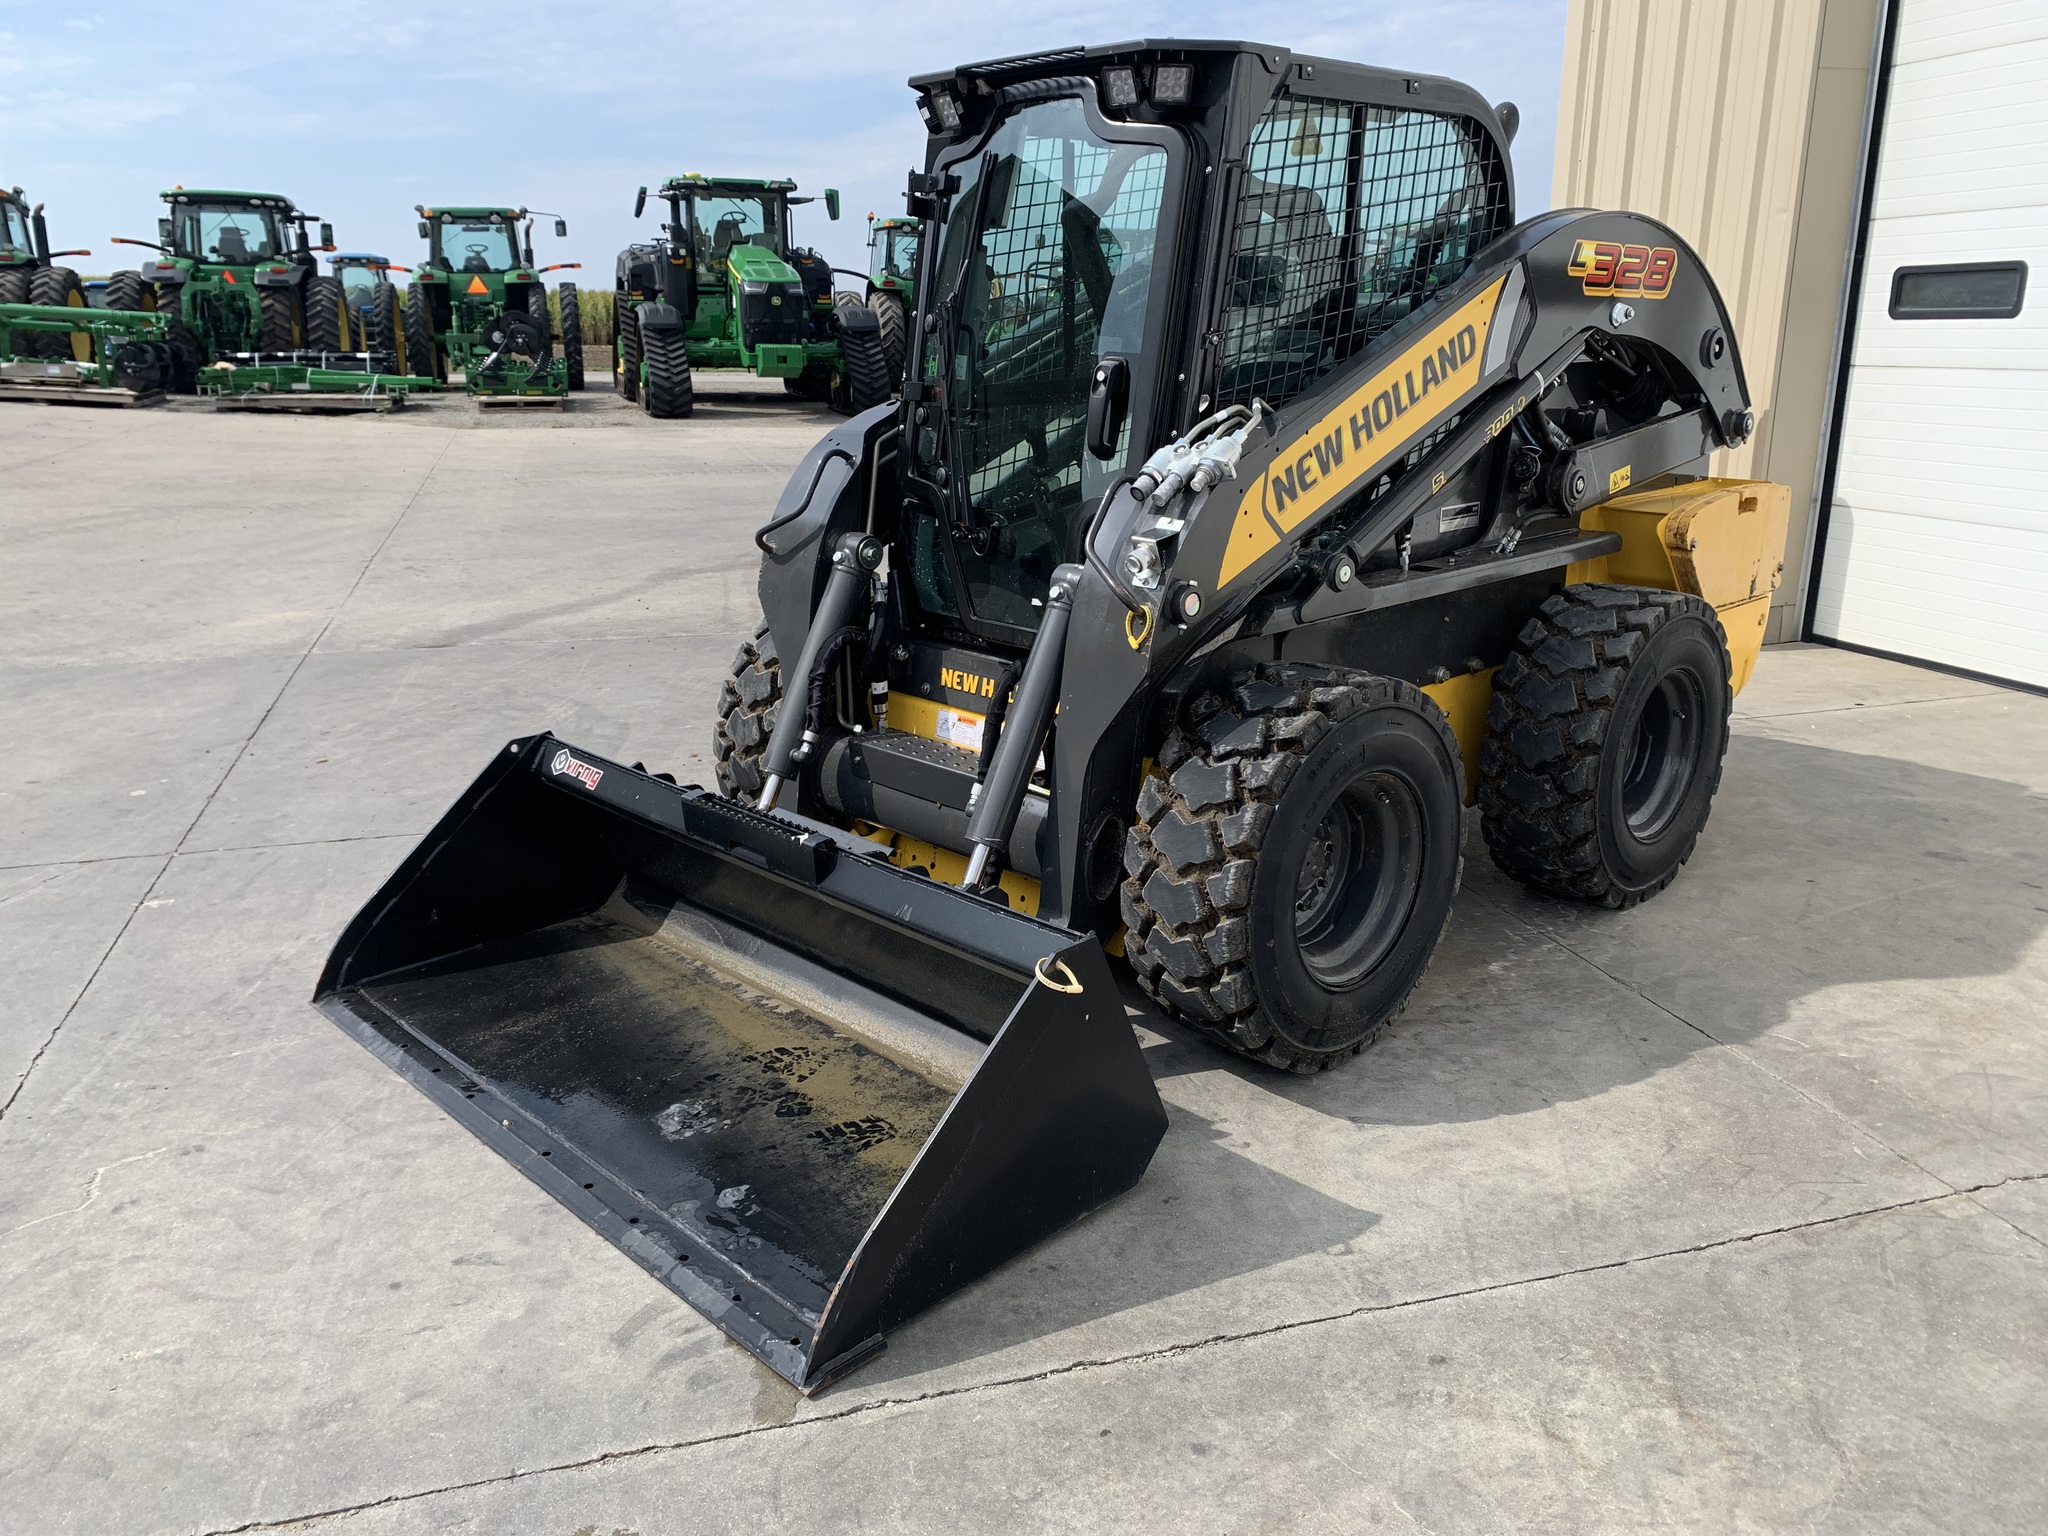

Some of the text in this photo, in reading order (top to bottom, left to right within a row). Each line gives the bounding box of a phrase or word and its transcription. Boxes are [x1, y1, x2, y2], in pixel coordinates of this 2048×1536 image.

[1568, 240, 1677, 297] L328
[1271, 323, 1477, 514] NEW HOLLAND
[940, 667, 979, 695] NEW
